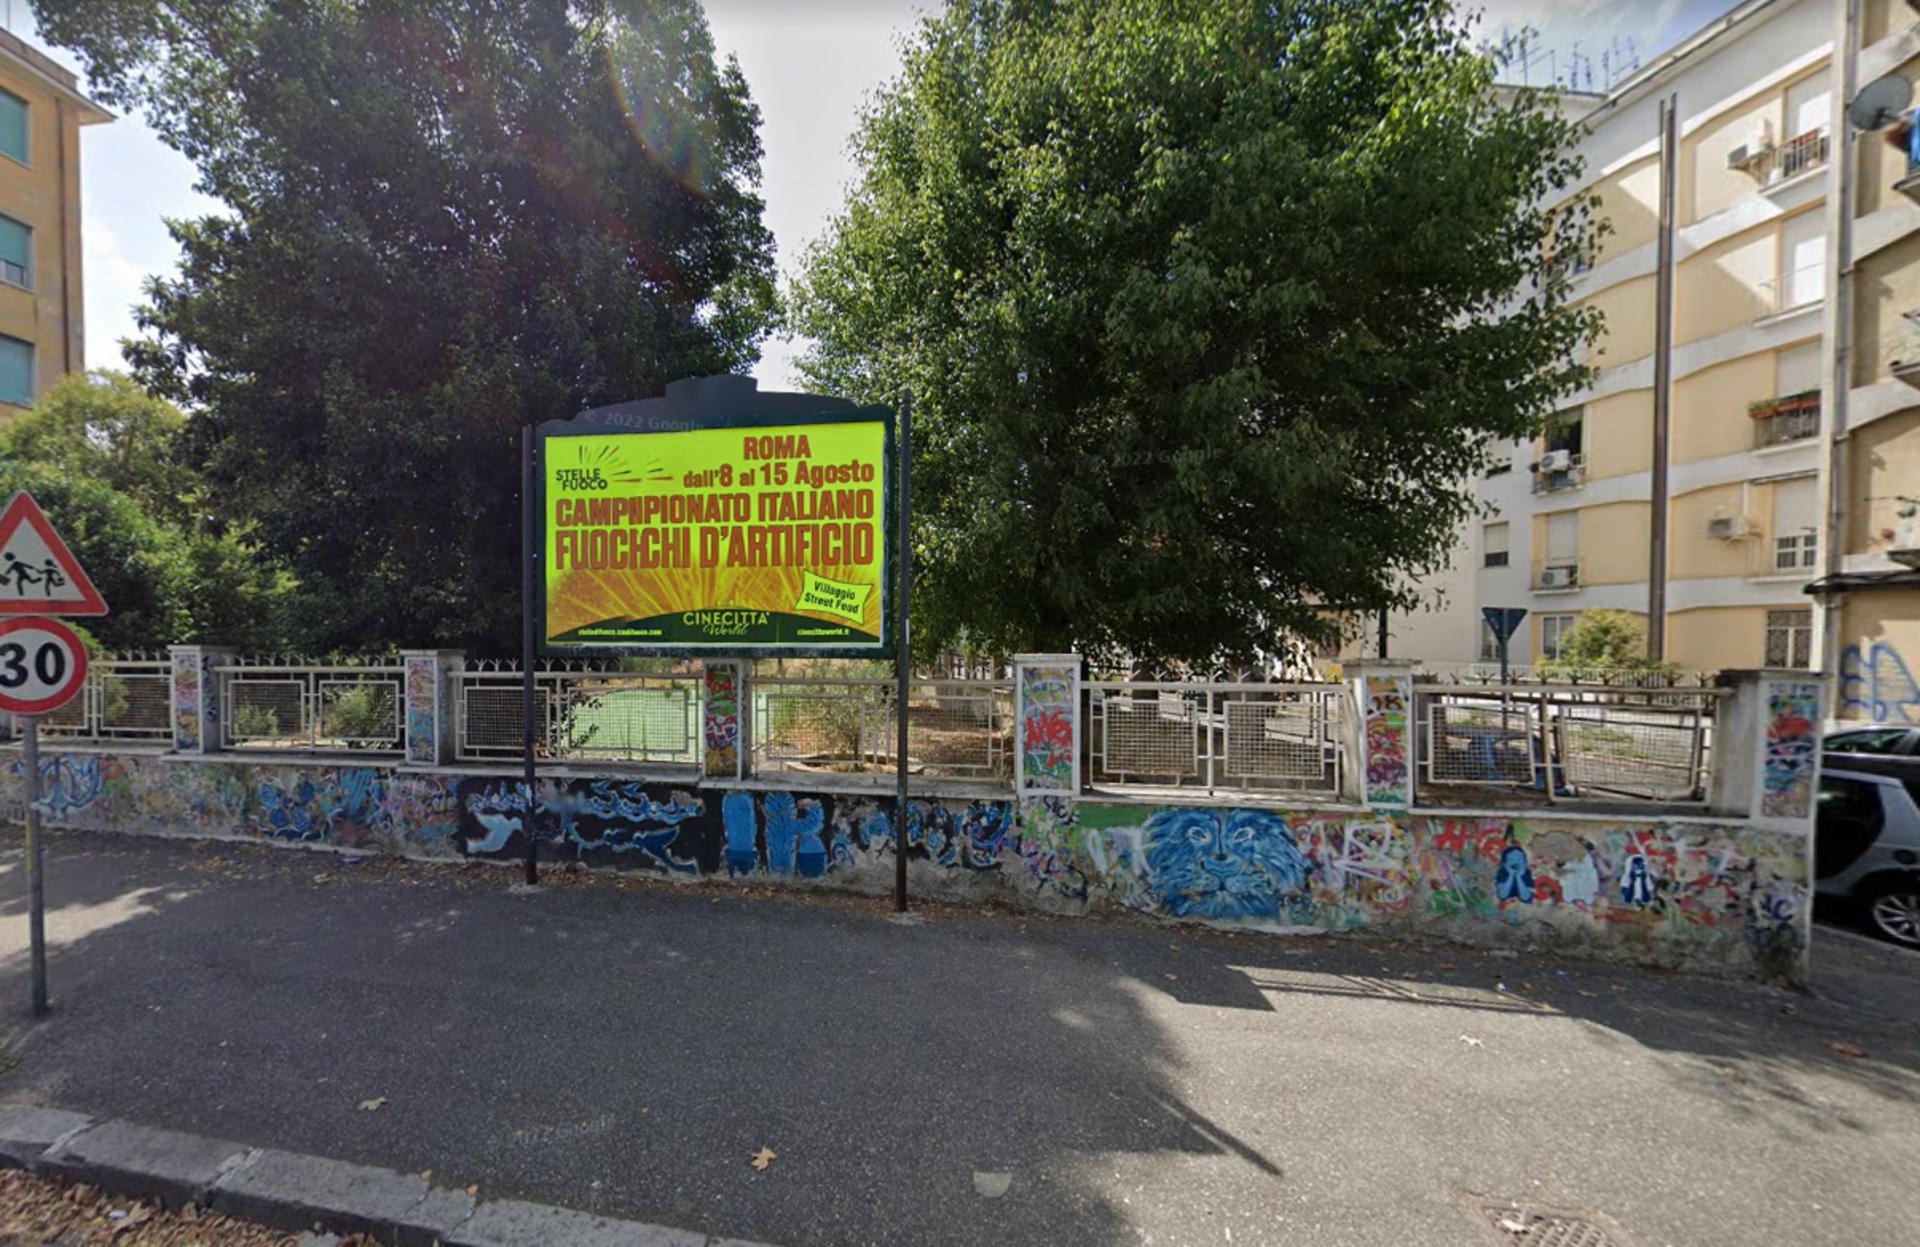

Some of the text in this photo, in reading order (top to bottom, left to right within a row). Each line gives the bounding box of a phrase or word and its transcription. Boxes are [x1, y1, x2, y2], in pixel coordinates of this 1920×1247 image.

[743, 435, 812, 460] ROMA
[556, 468, 601, 481] STELLE
[562, 479, 608, 491] FUOCO
[683, 459, 874, 489] dall'8 al 15 Agosto
[758, 489, 874, 521] ITALIANO
[700, 522, 874, 567] D'ARTIFICIO
[804, 592, 859, 614] Street Food
[814, 581, 856, 600] Villaggio
[0, 642, 65, 688] 30
